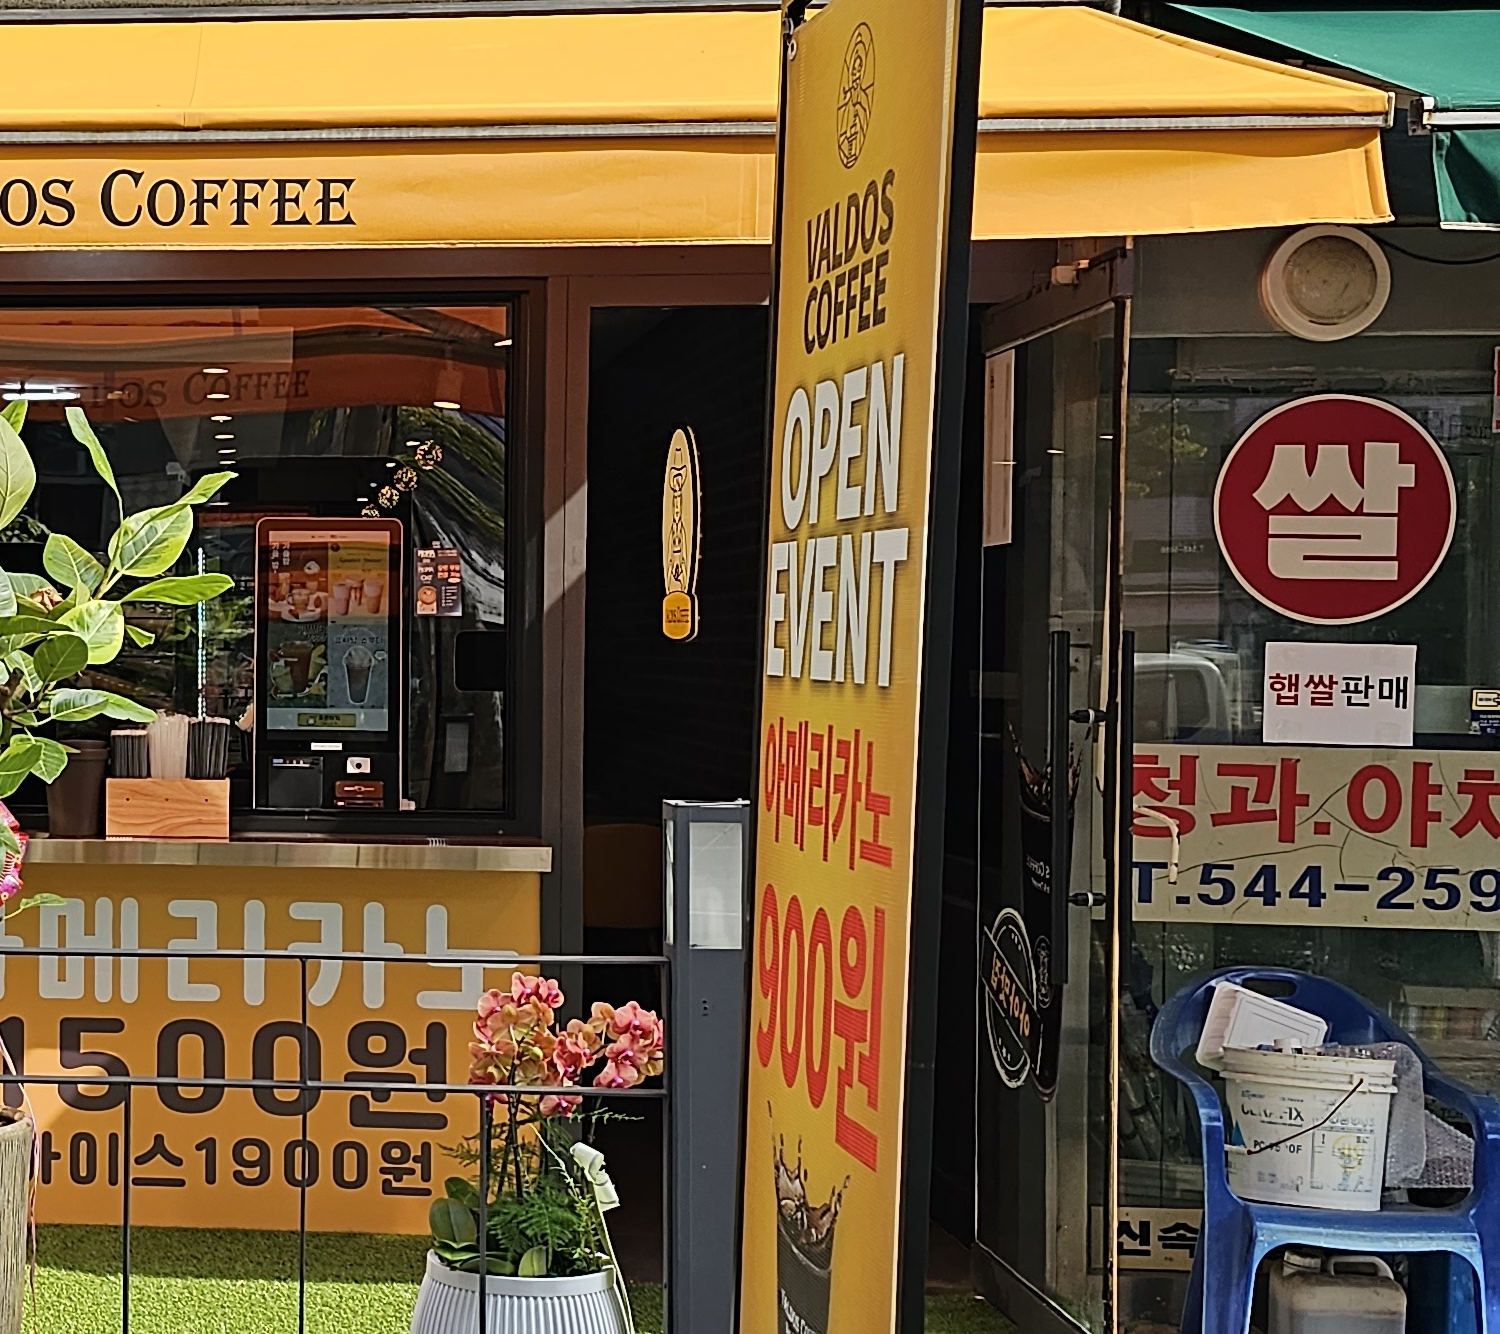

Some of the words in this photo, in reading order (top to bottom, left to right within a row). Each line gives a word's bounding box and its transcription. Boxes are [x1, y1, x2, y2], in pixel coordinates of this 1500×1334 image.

[100, 168, 358, 227] COFFEE
[806, 168, 895, 283] VALDOS
[803, 249, 889, 355] COFFEE
[781, 353, 904, 530] OPEN
[1252, 442, 1415, 580] 쌀
[766, 528, 909, 687] EVENT
[1268, 672, 1409, 710] 햅쌀판매
[763, 716, 892, 871] 아메리카노
[756, 883, 886, 1173] 900원
